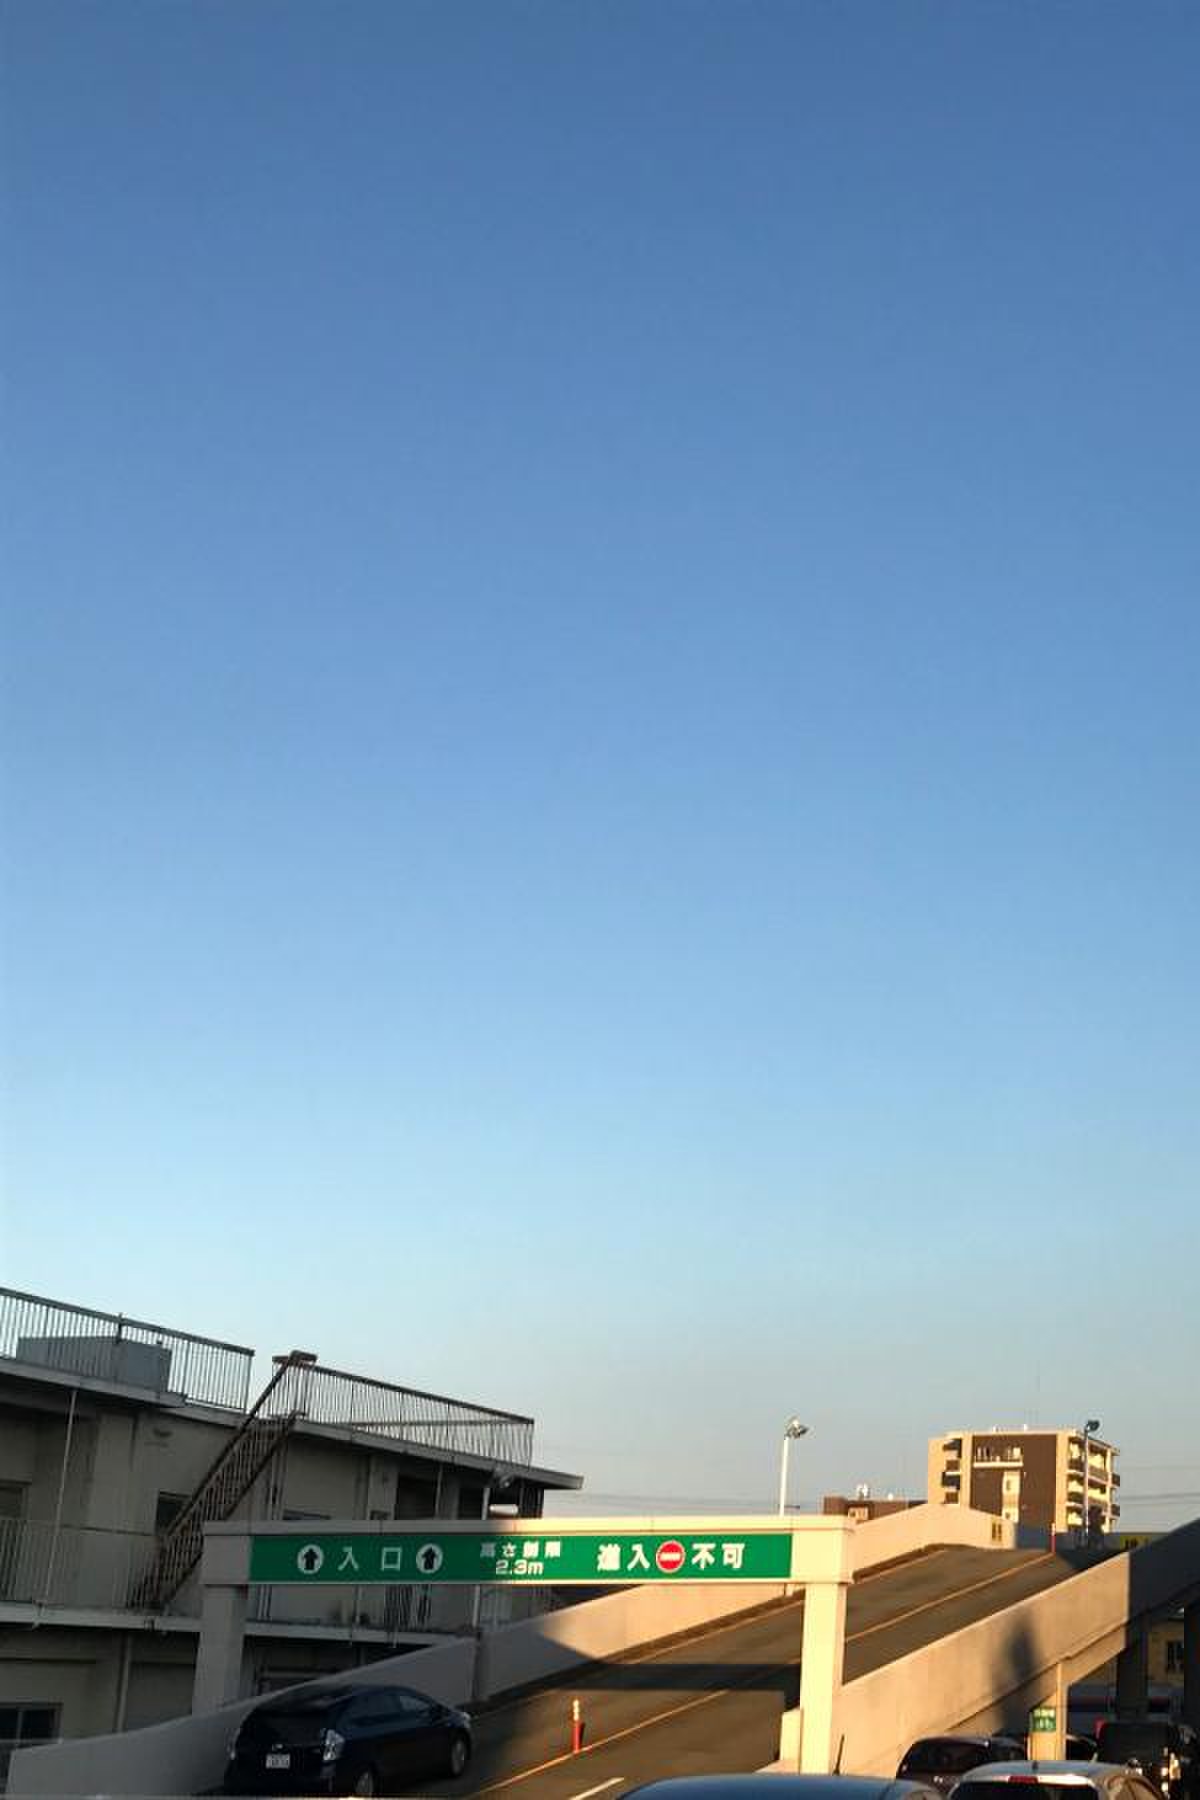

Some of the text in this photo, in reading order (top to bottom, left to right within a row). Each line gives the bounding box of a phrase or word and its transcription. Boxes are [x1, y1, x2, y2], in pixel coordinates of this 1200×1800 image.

[338, 1546, 403, 1572] 入口
[495, 1559, 544, 1575] 2.3m
[691, 1543, 746, 1571] 不可
